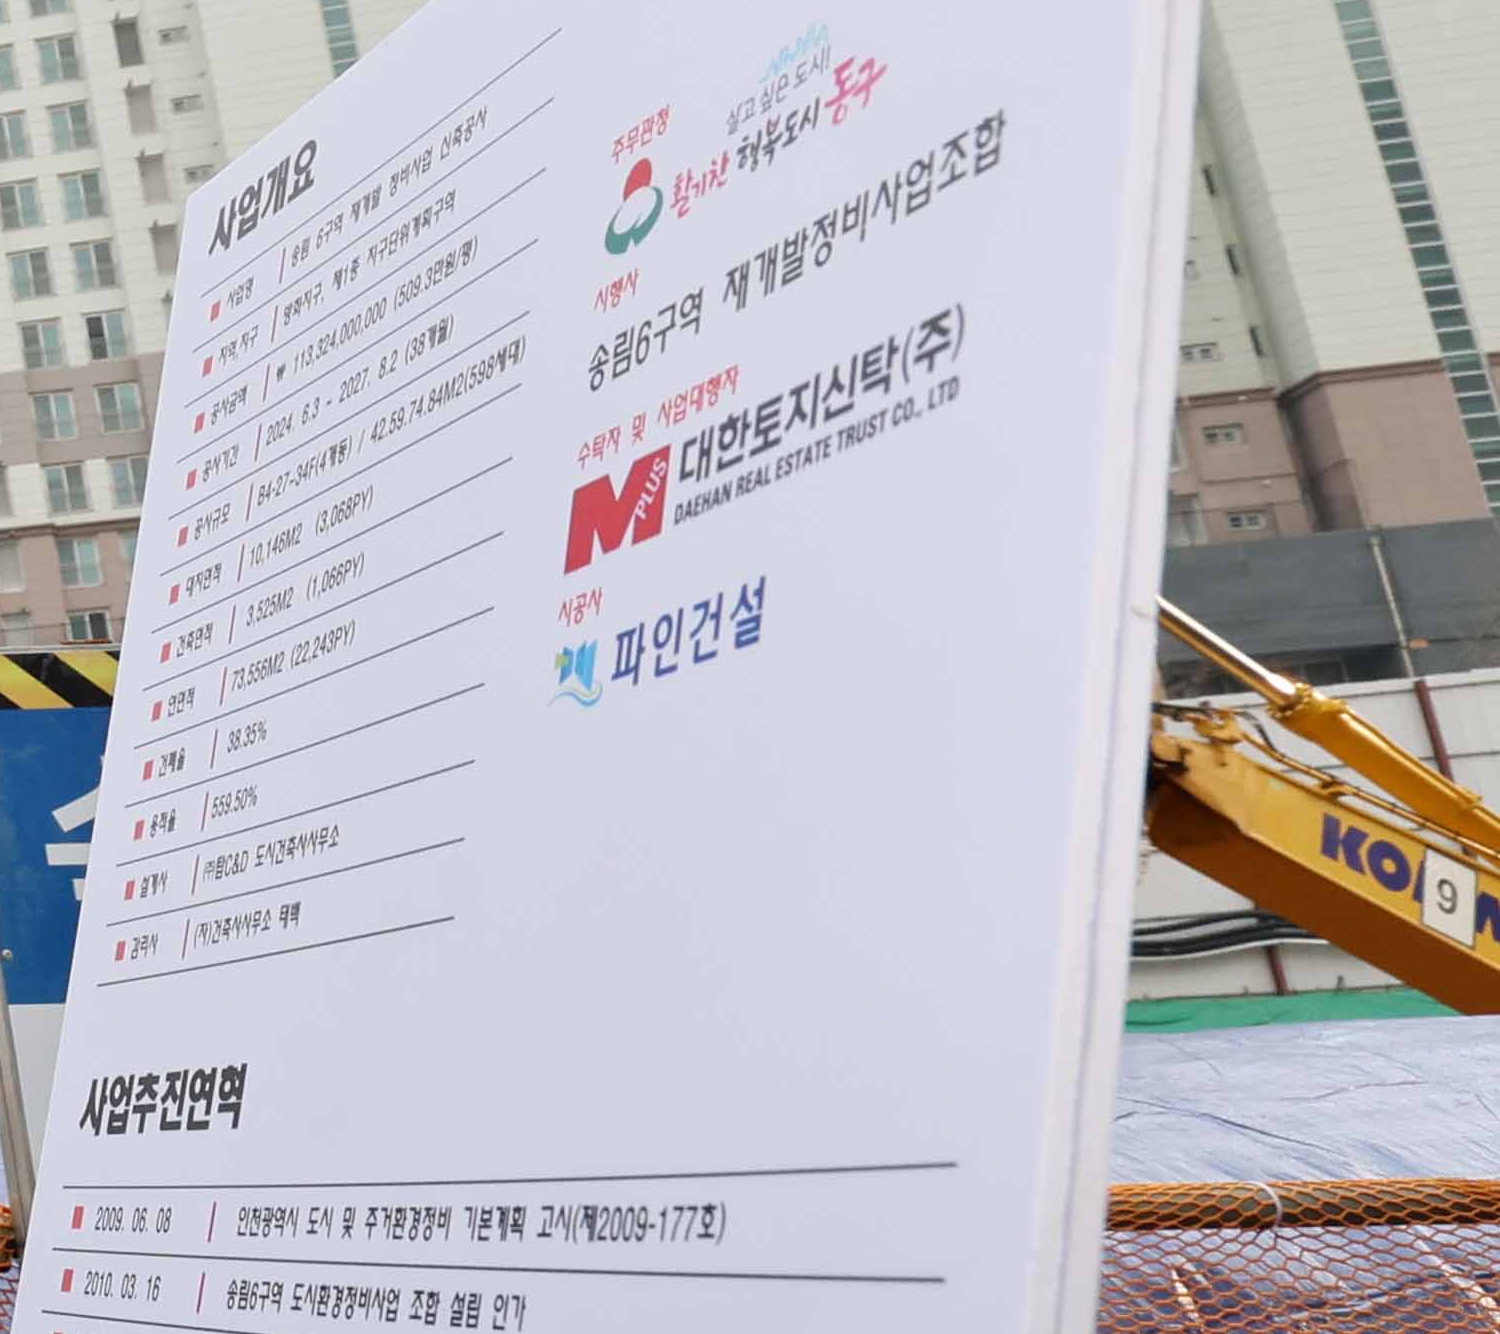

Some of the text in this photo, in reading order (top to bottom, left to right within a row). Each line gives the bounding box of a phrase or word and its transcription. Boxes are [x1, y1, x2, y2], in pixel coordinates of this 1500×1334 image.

[670, 55, 888, 219] 활기찬 행복도시 동구
[209, 139, 318, 255] 사업개요
[227, 277, 255, 308] 사업명
[291, 235, 310, 268] 송림
[316, 213, 343, 250] 6구역
[389, 146, 433, 197] 정비사업
[440, 106, 488, 163] 신축공사
[588, 106, 1007, 393] 송림6구역 재개발정비사업조합
[595, 267, 639, 313] 시행사
[203, 314, 454, 482] 공사기간 2024. 6.3 2027. 8.2 (38개월)
[211, 386, 248, 425] 공사금액
[577, 365, 740, 470] 수탁자 및 사업대행자
[678, 302, 966, 484] 대한토지신탁(주)
[673, 482, 732, 526] DAEHAN
[735, 468, 772, 499] REAL
[775, 438, 832, 482] ESTATE
[836, 409, 889, 453] TRUST
[927, 375, 961, 411] LTD
[194, 502, 231, 541] 공사규모
[634, 456, 669, 521] PLUS
[185, 485, 374, 598] 대지면적 10,146M2 (3,068PY)
[176, 553, 365, 658] 건축면적 3,525M2 (1,066PY)
[558, 587, 604, 628] 시공사
[610, 575, 767, 688] 파인건설
[167, 620, 356, 717] 연면적 73,556M2 (22,243PY)
[227, 720, 267, 754] 38.35%
[211, 786, 258, 819] 559.50%
[140, 823, 341, 898] 설계사 도시건축사사무소
[1436, 878, 1458, 915] 9
[130, 934, 159, 961] 감리사
[78, 1063, 248, 1137] 사업추진연혁
[94, 1201, 727, 1245] 2009. 06. 08 인천광역시 도시 및 주거환경정비 기본계획 고시(제2009-177호)
[83, 1269, 527, 1332] 2010. 03. 16 송림6구역 도시환경정비사업 조합 설립 인가
